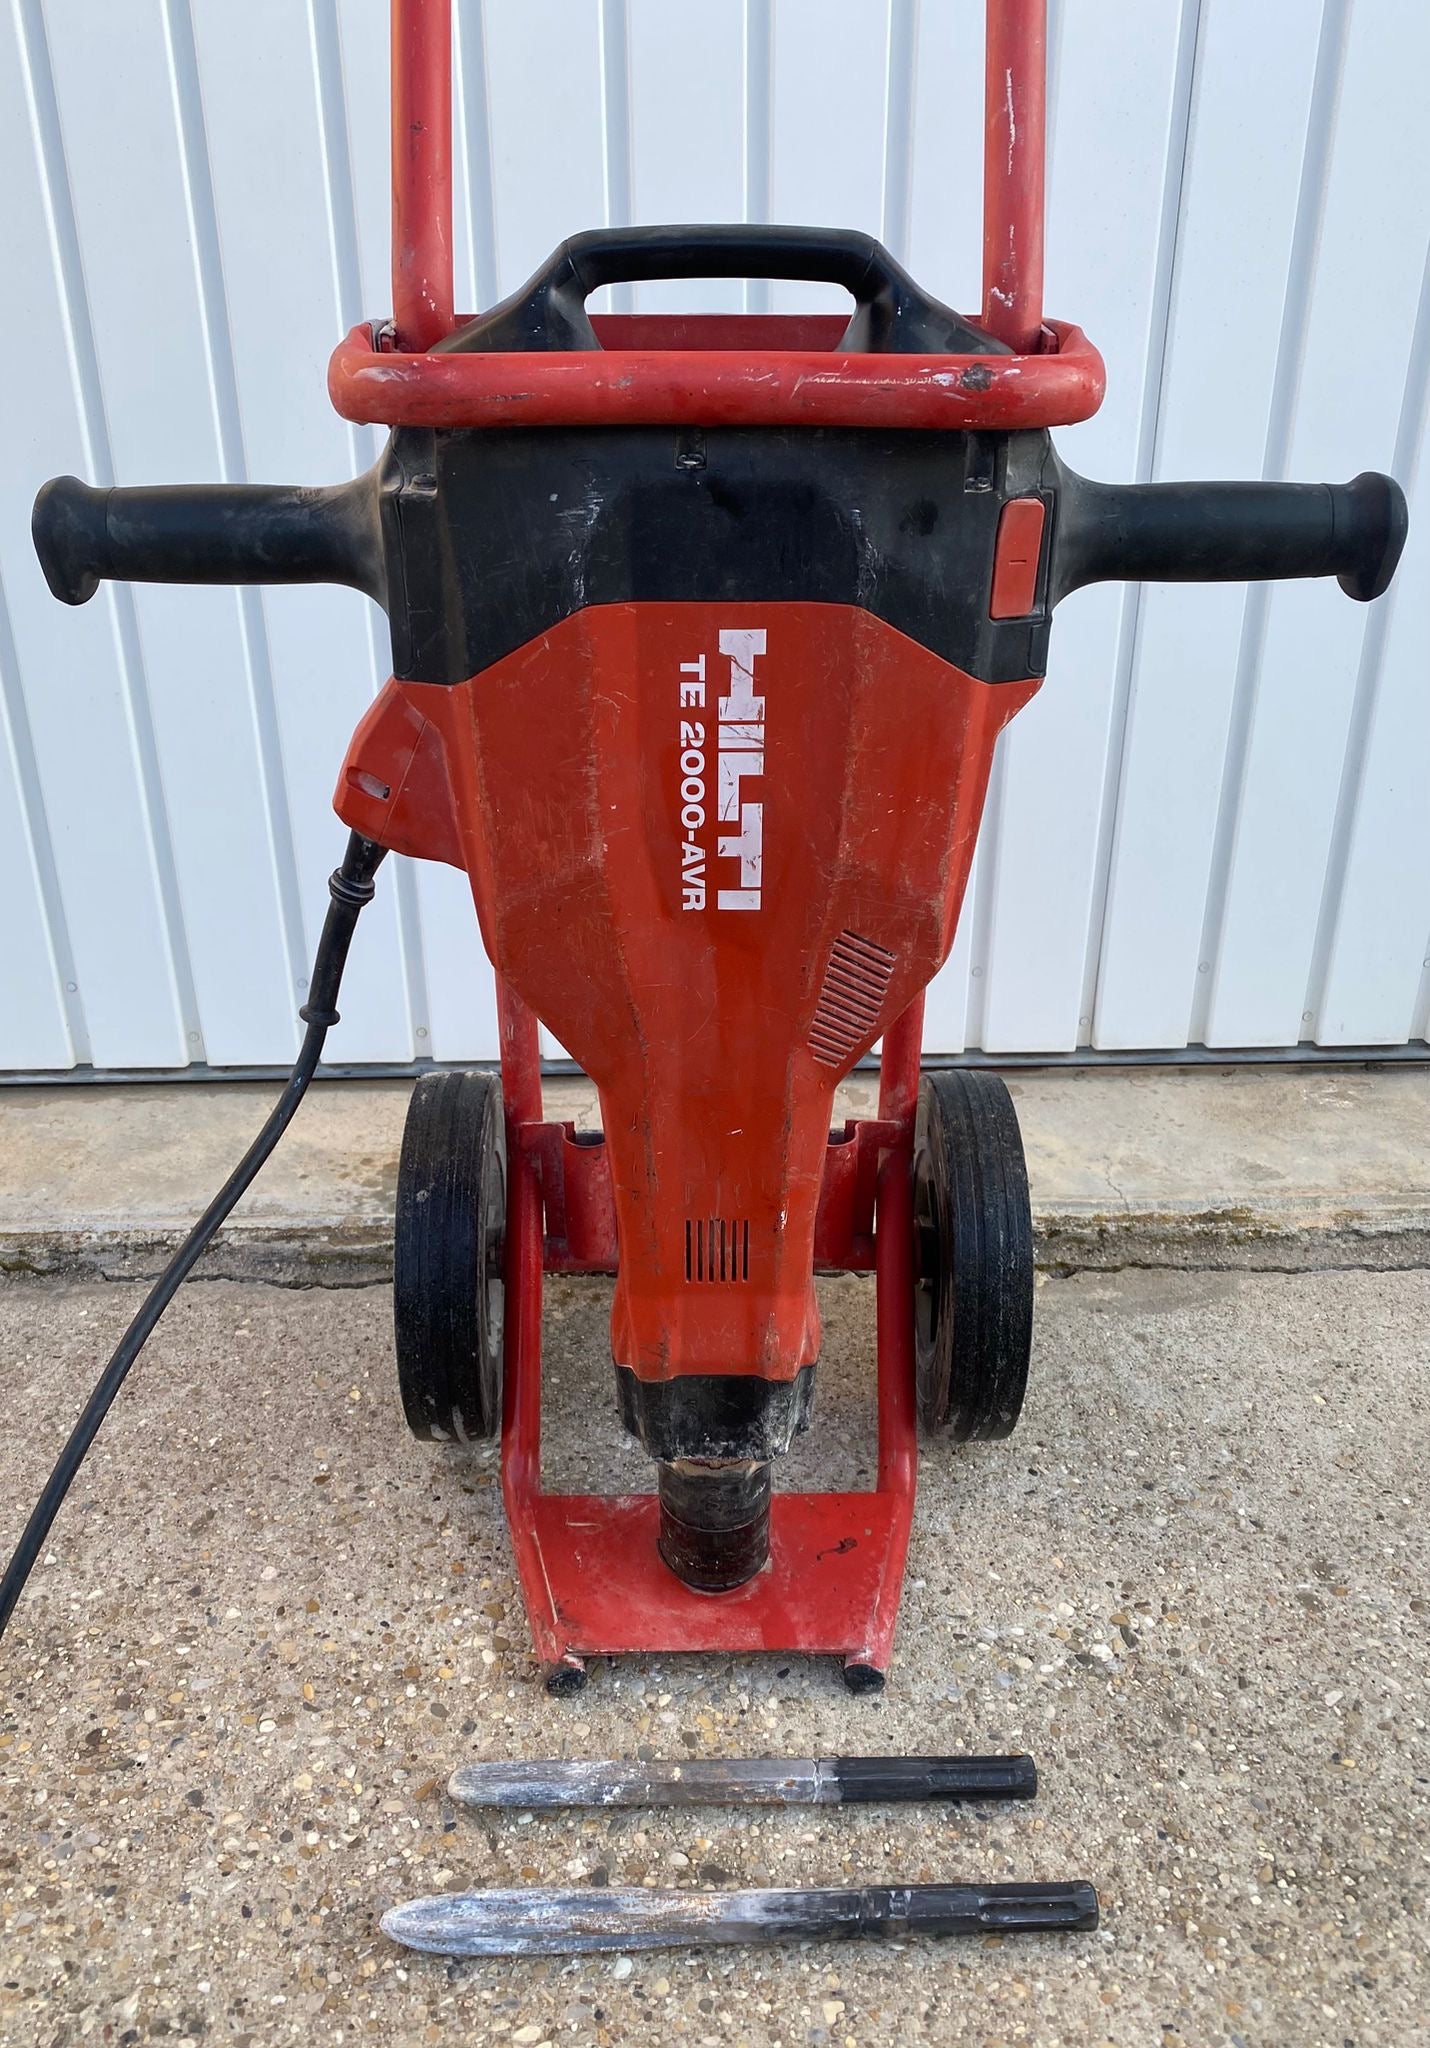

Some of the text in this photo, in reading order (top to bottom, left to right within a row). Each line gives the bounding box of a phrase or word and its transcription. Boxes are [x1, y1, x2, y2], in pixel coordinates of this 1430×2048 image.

[680, 654, 706, 911] TE 2000-AVR
[718, 629, 766, 910] HILTI
